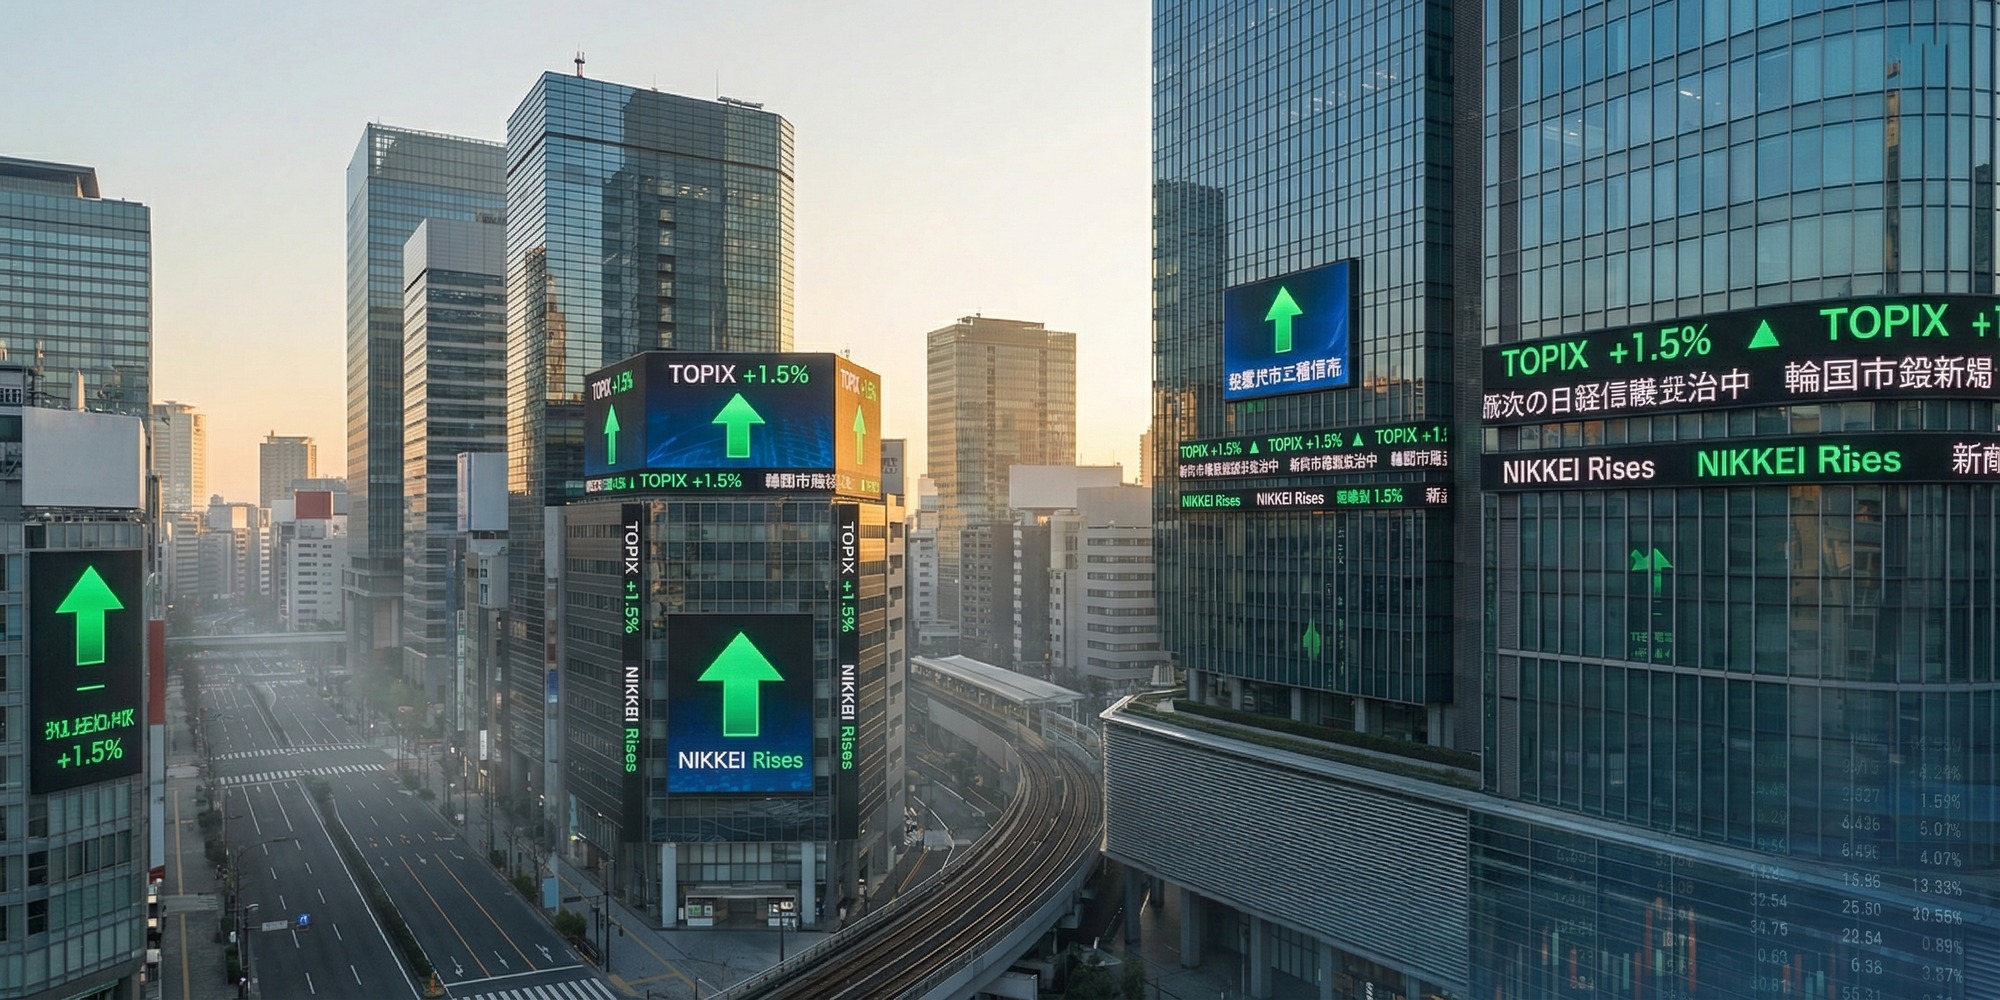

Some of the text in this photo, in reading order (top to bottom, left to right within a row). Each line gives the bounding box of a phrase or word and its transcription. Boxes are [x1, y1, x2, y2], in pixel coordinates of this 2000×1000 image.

[1819, 303, 1949, 341] TOPIX
[1501, 323, 1712, 377] TOPIX +1.5%
[591, 376, 612, 401] TOPIX
[669, 364, 810, 385] TOPIX +1.5%
[1180, 444, 1209, 459] TOPIX
[1211, 441, 1242, 456] +1.5%
[1268, 436, 1303, 452] TOPIX
[1306, 432, 1343, 450] +1.5%
[1375, 426, 1417, 445] TOPIX
[1503, 455, 1656, 484] NIKKEI Rises
[1697, 445, 1902, 478] NIKKEI Rises
[639, 473, 688, 488] TOPIX
[692, 473, 742, 488] +1.5%
[1374, 488, 1403, 503] 1.5%
[1182, 493, 1241, 508] NIKKEI Rises
[1256, 492, 1292, 506] NIKKEI
[1295, 490, 1325, 505] Rises
[625, 520, 640, 634] TOPIX +1.5%
[841, 520, 855, 633] TOPIX +1.5%
[57, 737, 123, 769] +1.5%
[625, 728, 640, 773] Rises
[678, 751, 804, 769] NIKKEI Rises
[841, 725, 856, 770] Rises
